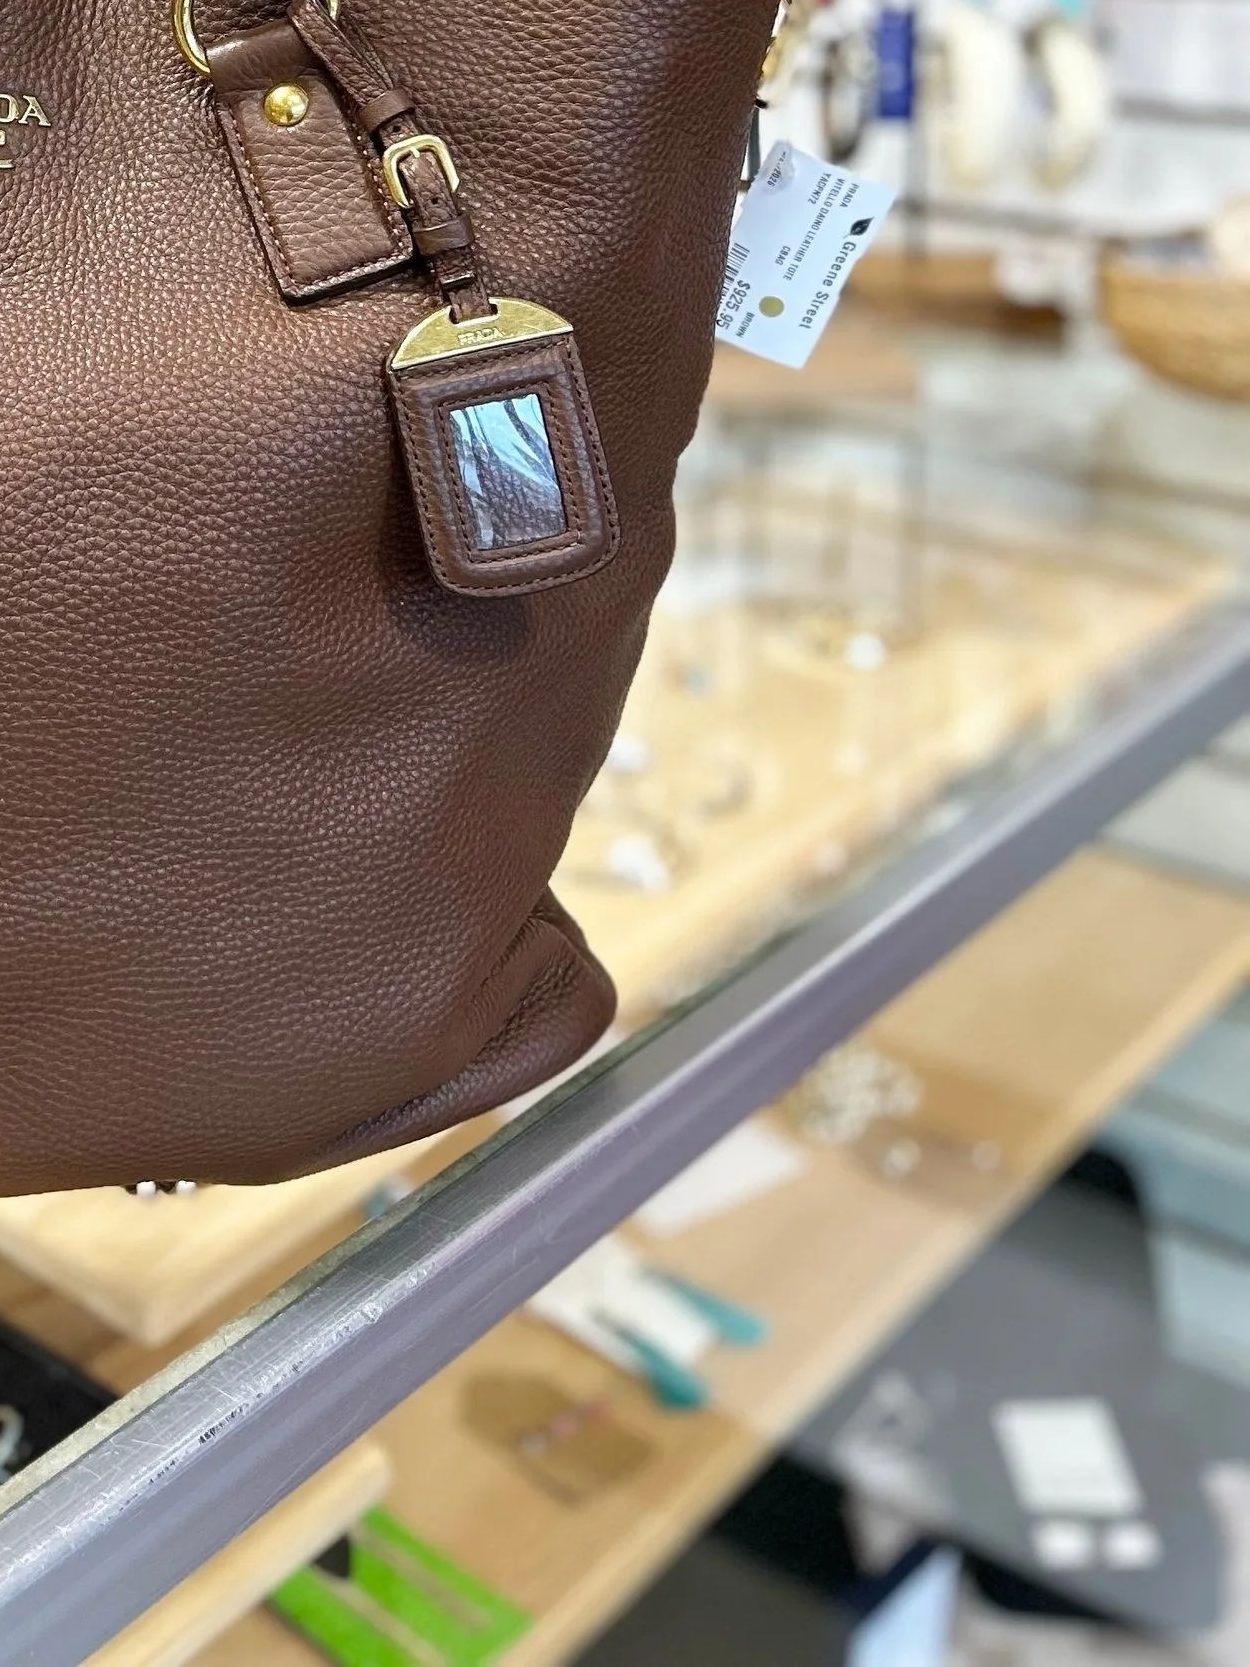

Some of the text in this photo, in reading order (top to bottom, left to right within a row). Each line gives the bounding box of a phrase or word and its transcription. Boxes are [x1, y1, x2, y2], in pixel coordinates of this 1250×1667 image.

[839, 183, 858, 208] PRADA
[782, 177, 845, 281] VITELLO DAINO LEATHER TOTE
[715, 279, 751, 329] $925.95
[798, 240, 857, 331] Greene Street
[457, 326, 504, 346] PRADA
[735, 311, 755, 338] BROWN
